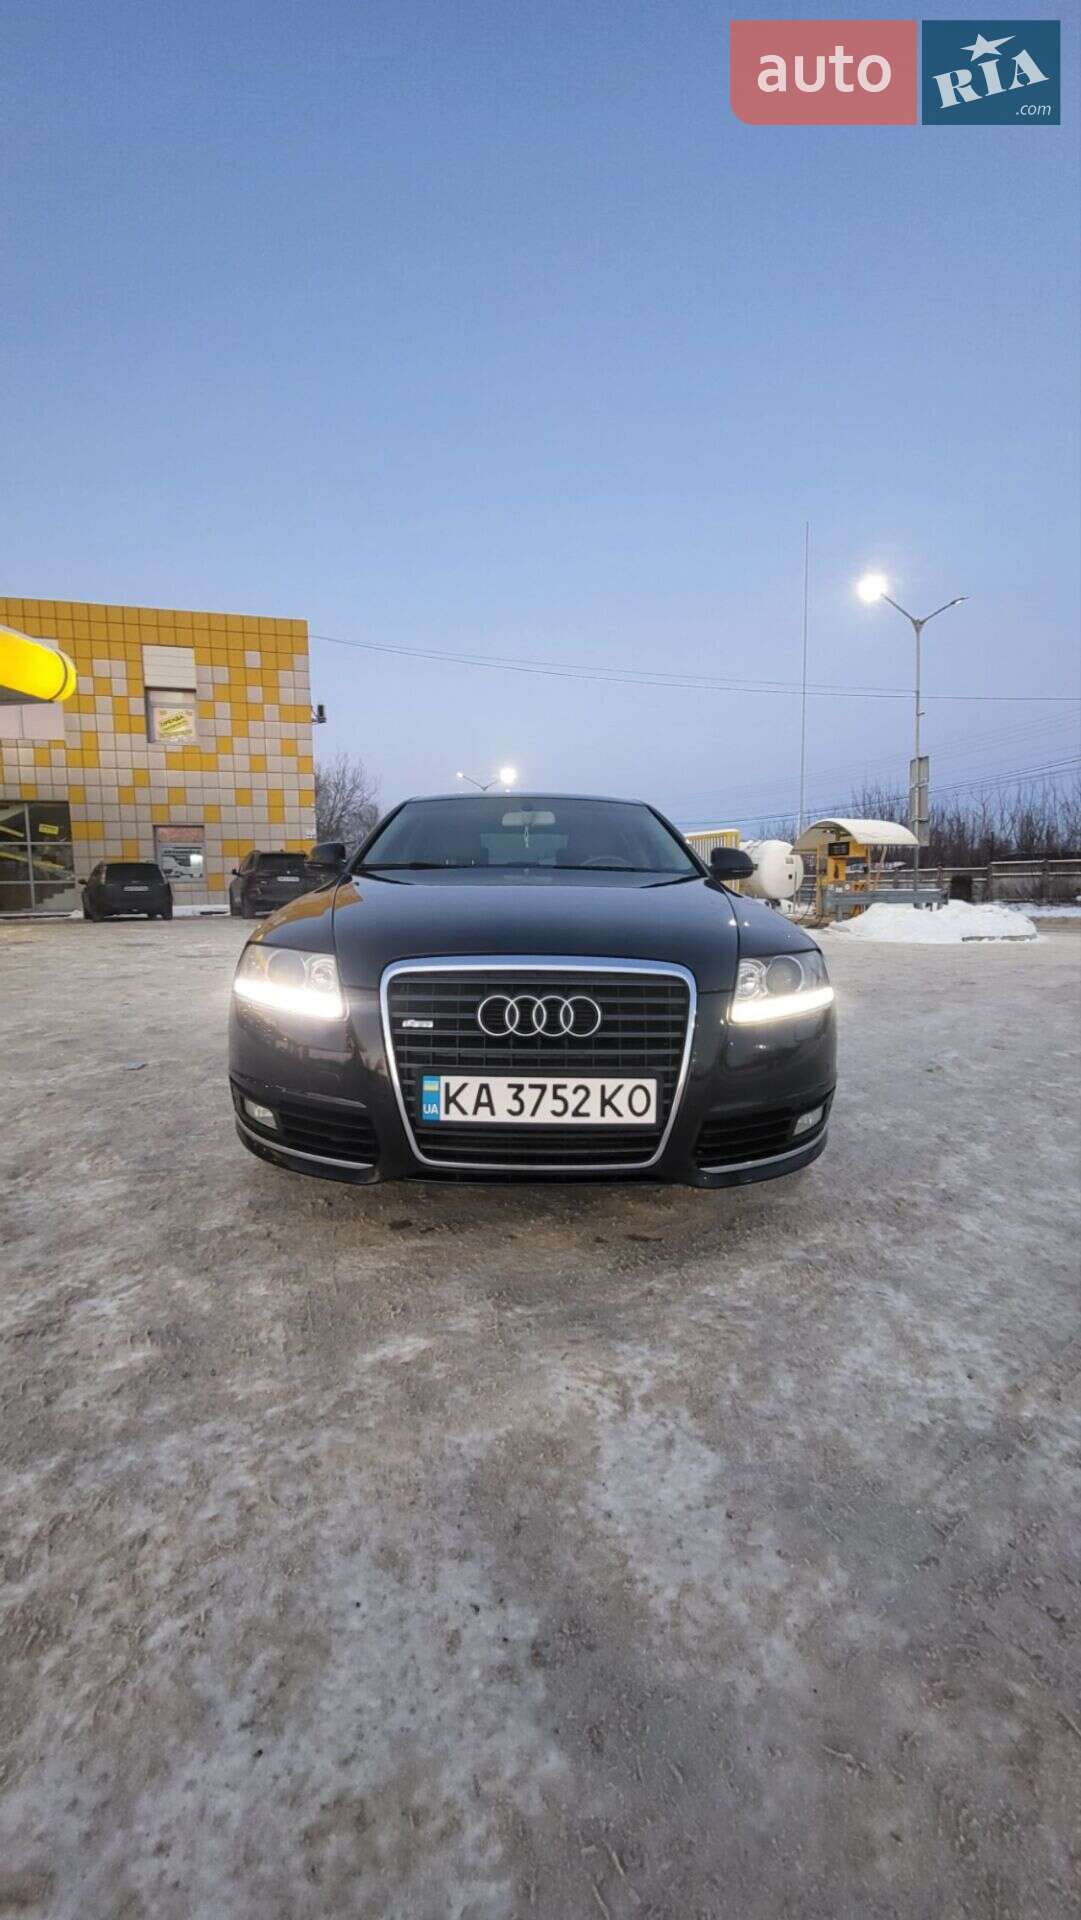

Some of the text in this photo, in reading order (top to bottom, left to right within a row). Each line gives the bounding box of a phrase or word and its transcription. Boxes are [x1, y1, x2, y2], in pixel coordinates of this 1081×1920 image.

[423, 1103, 439, 1115] UA
[444, 1082, 651, 1118] KA 3752 KO
